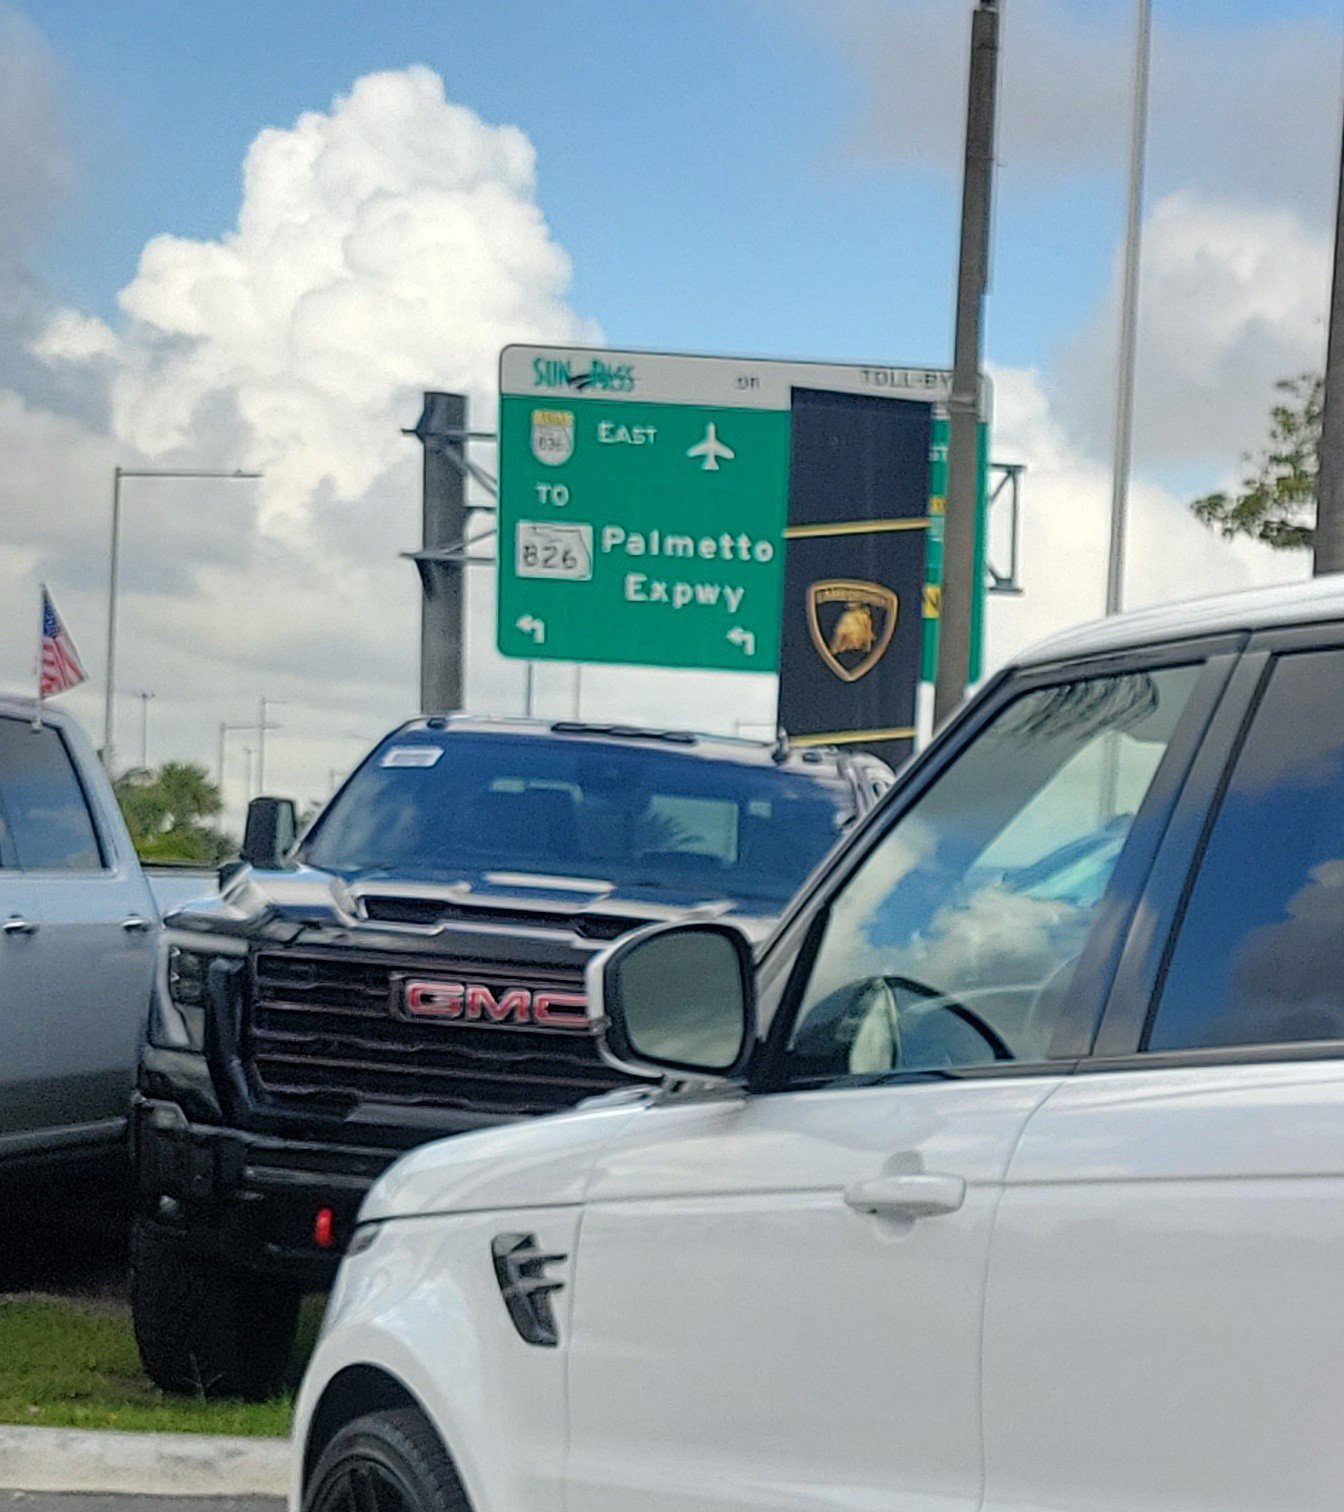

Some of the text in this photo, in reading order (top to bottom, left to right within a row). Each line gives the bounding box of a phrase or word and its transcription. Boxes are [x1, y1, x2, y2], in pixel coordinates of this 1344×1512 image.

[598, 420, 657, 445] EAST
[535, 482, 569, 506] TO
[523, 544, 578, 569] 826
[602, 525, 774, 562] Palmetto
[624, 572, 745, 613] Expwy
[405, 979, 593, 1027] GMC
